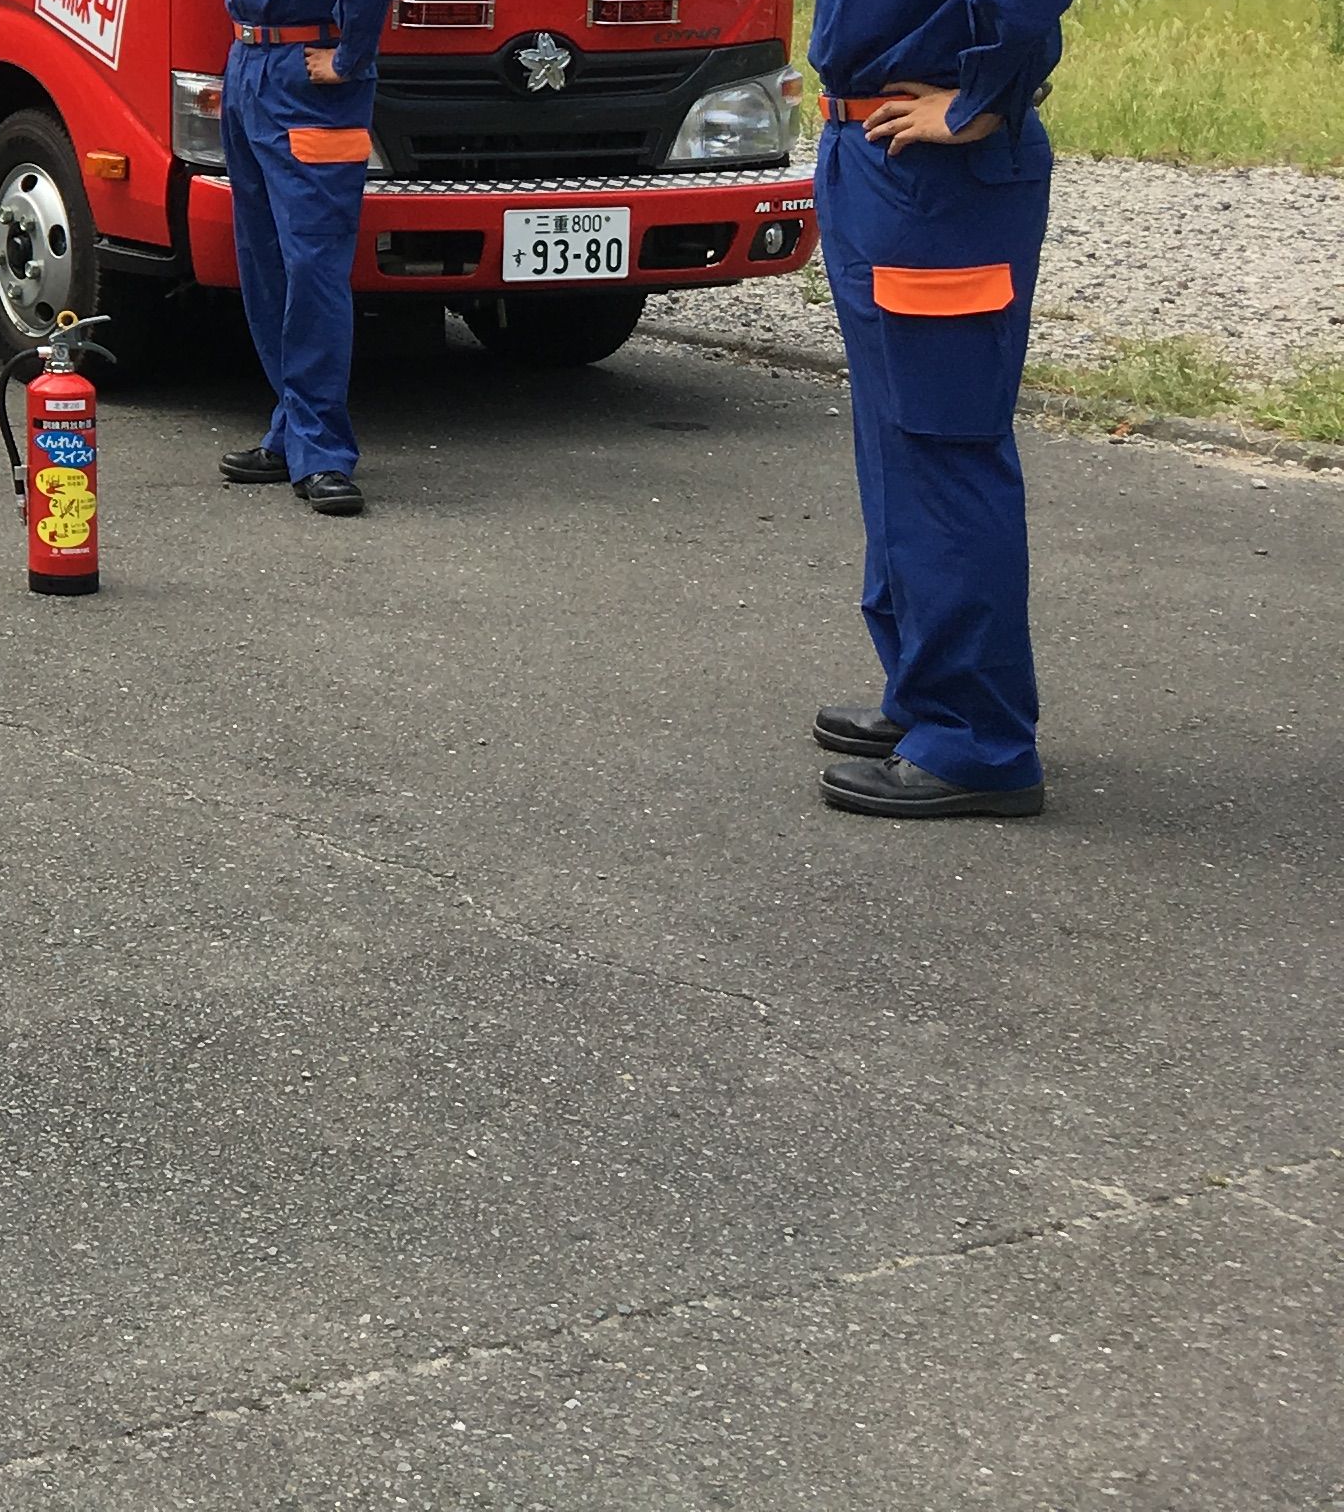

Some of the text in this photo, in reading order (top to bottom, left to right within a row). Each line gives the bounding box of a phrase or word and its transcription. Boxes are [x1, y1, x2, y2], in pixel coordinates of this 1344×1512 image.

[512, 237, 623, 275] す 93-80
[36, 434, 83, 449] くんれん
[52, 448, 94, 464] スイスイ
